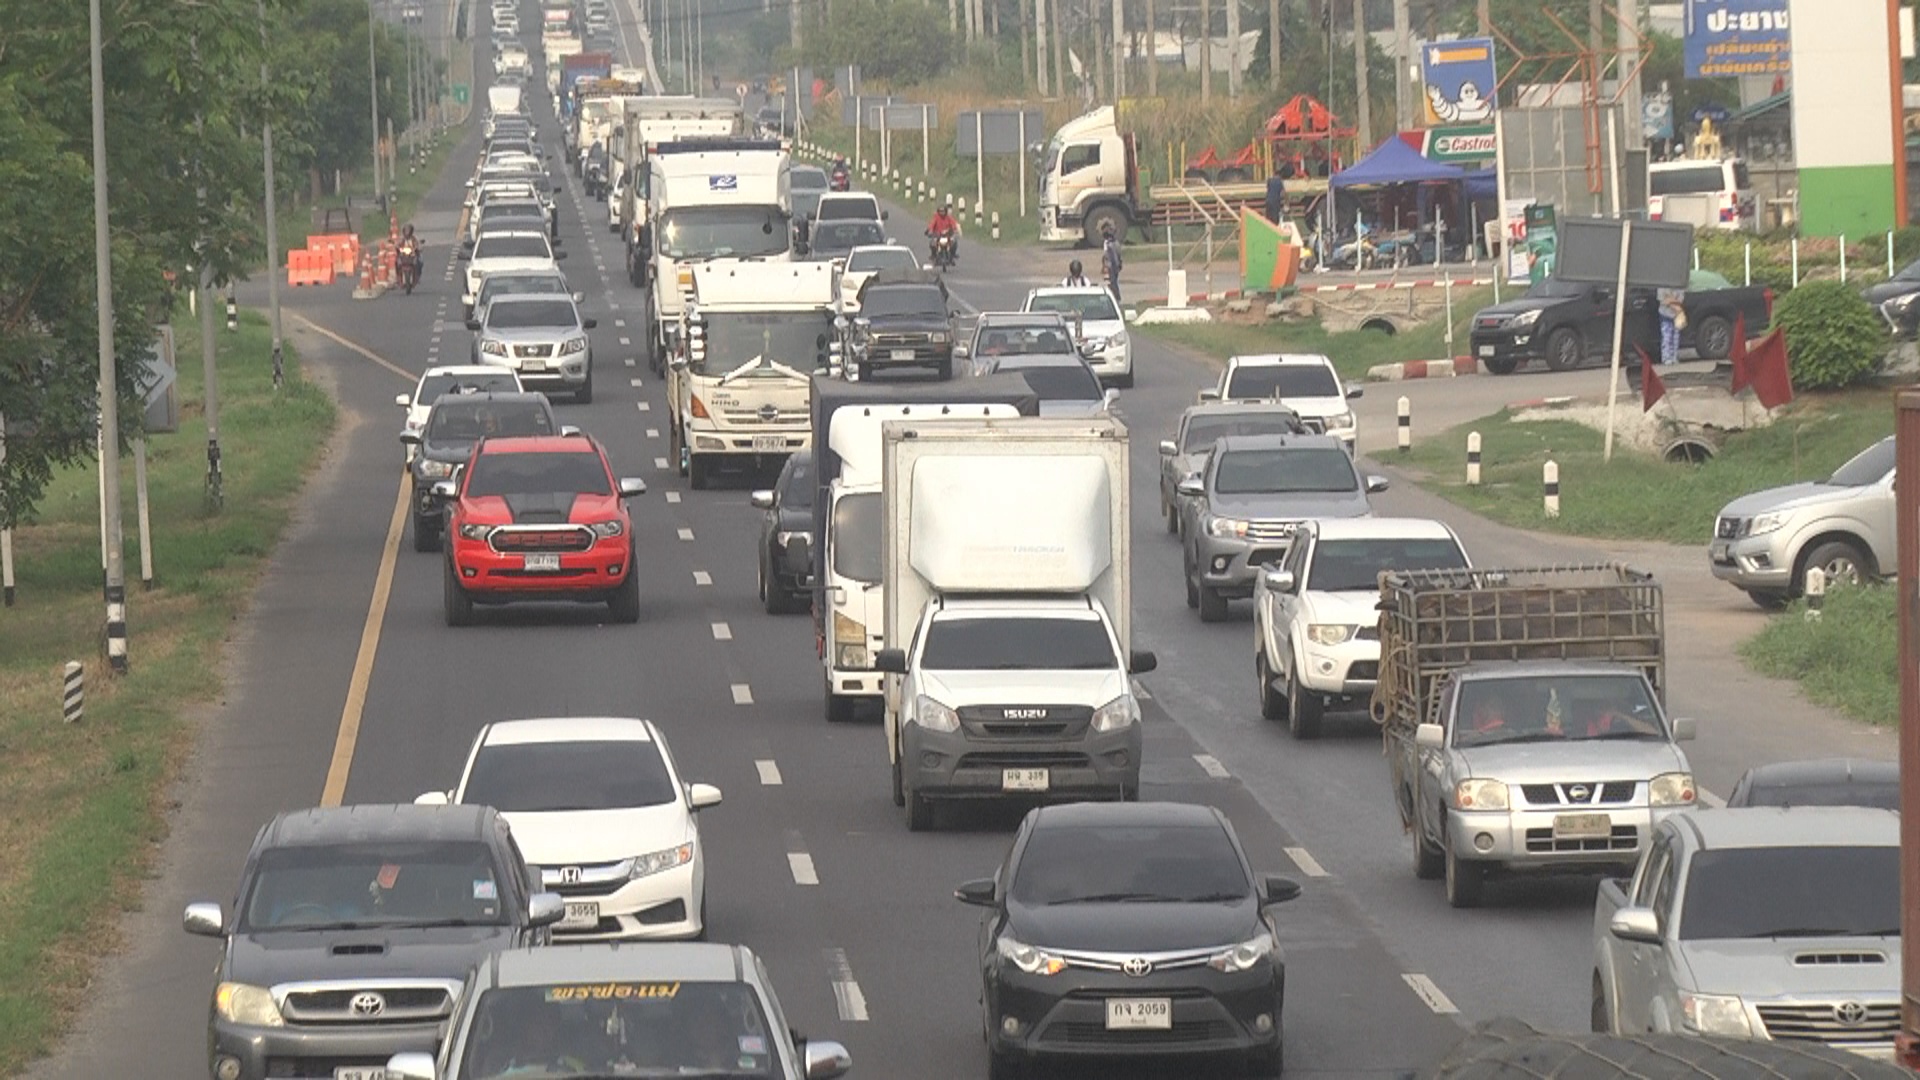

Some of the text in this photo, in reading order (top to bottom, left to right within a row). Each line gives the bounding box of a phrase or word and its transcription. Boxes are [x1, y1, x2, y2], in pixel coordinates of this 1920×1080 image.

[1706, 9, 1788, 32] ปะยาง
[1452, 137, 1496, 151] Castrol
[1003, 709, 1047, 719] ISUZU
[1137, 1003, 1167, 1015] 2059
